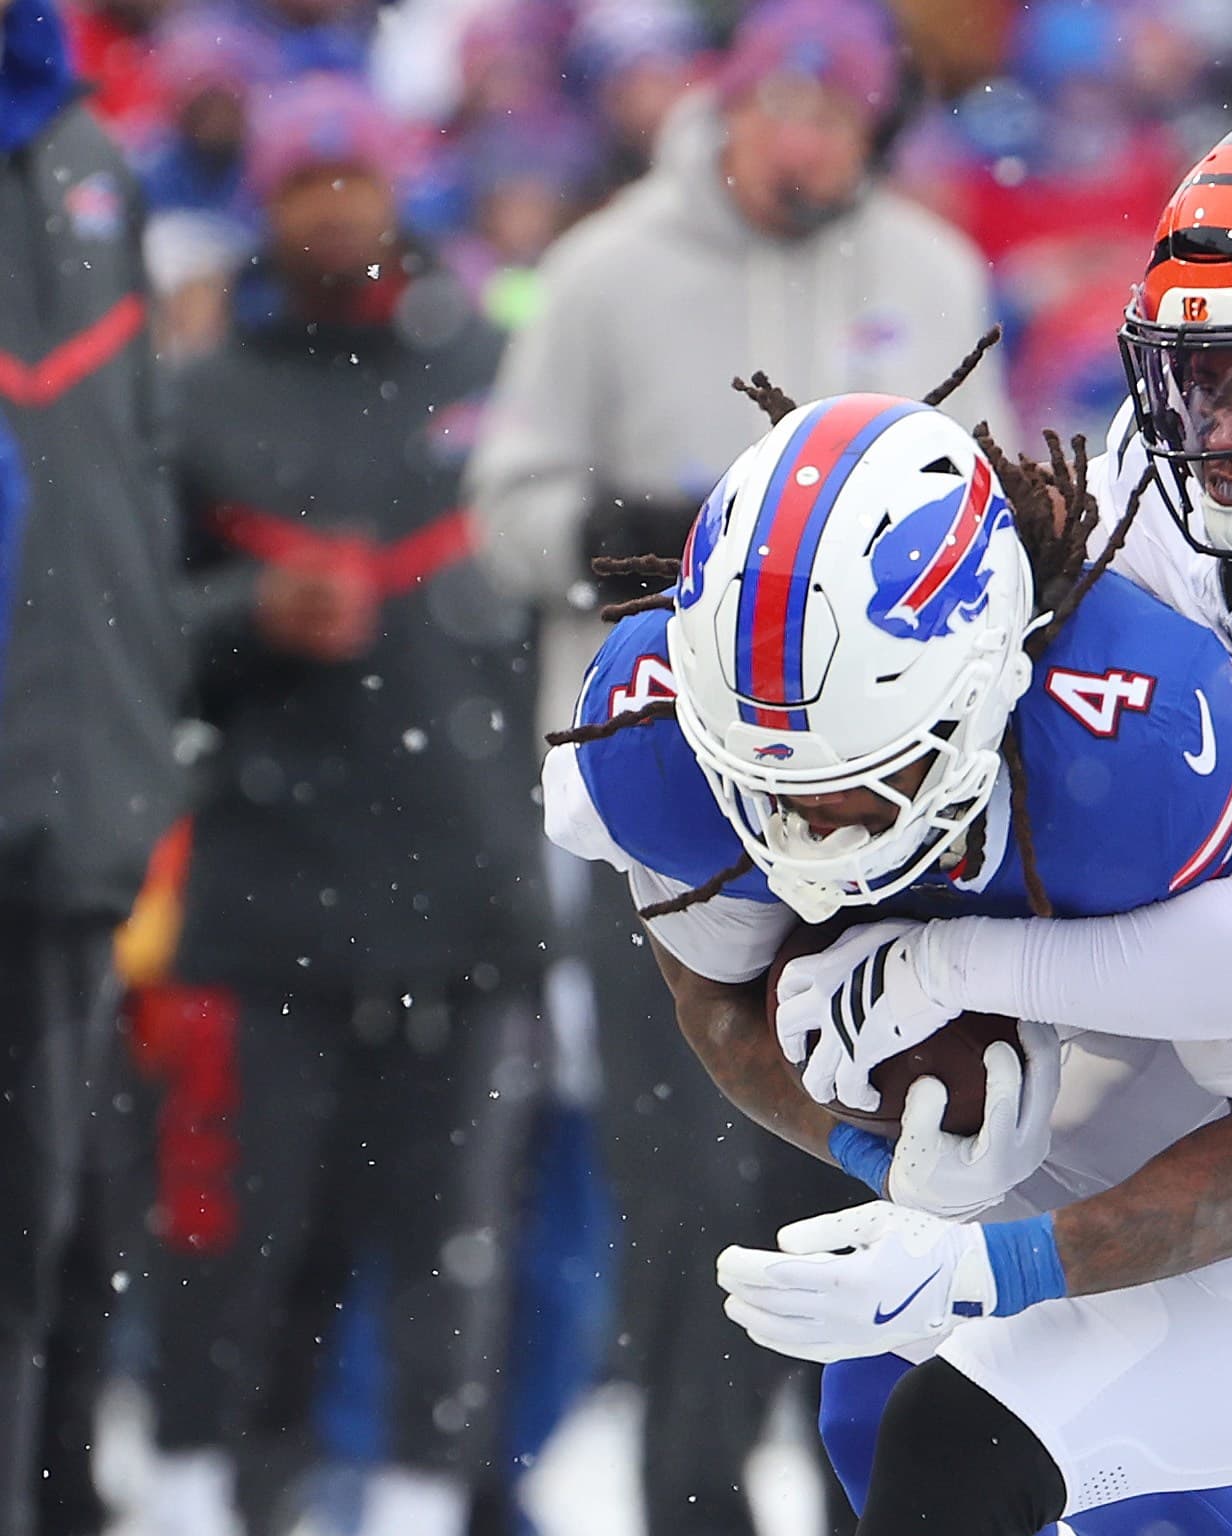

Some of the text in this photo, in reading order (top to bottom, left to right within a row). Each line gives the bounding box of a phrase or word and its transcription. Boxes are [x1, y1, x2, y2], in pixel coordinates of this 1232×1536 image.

[1181, 297, 1208, 321] B
[609, 653, 678, 724] 4
[1045, 665, 1156, 738] 4
